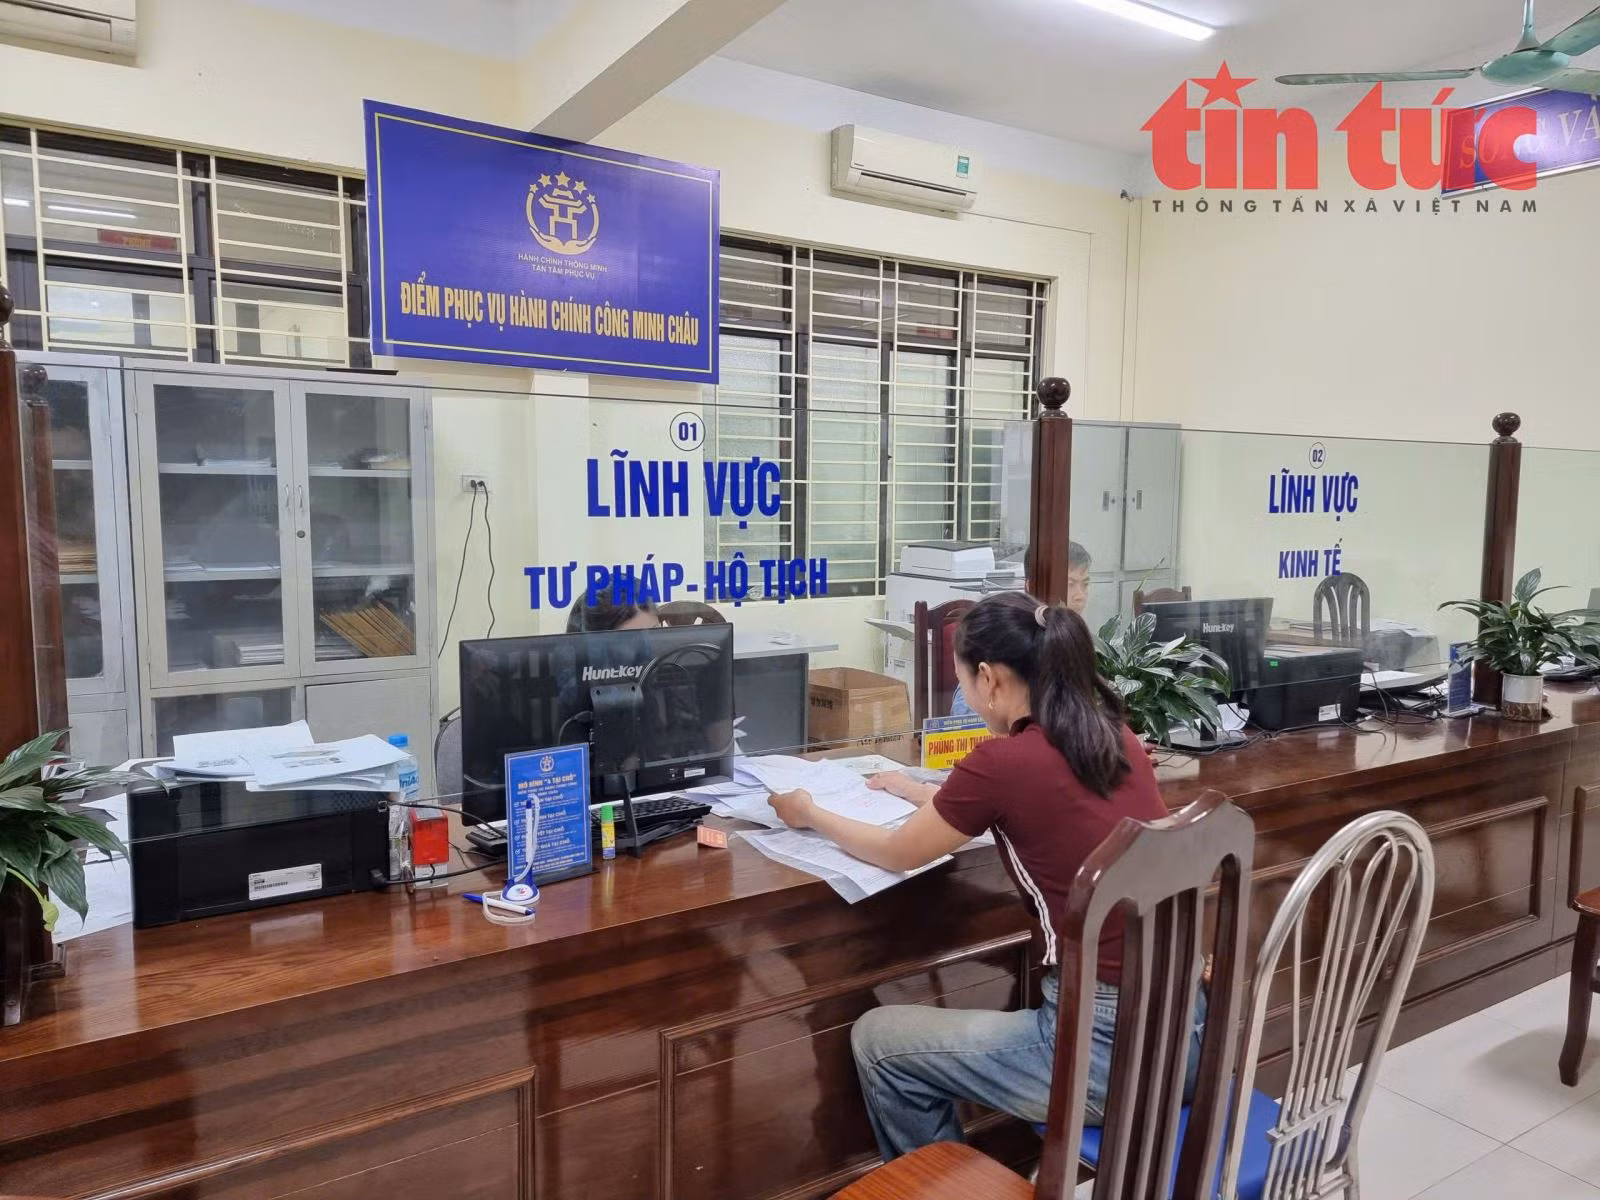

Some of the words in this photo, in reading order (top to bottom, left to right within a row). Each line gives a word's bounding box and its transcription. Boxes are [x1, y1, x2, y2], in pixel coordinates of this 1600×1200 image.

[400, 270, 441, 318] ĐIỂM
[444, 286, 484, 329] PHỤC
[487, 291, 506, 332] VỤ
[509, 289, 548, 330] HÀNH
[551, 296, 592, 335] CHÍNH
[594, 301, 630, 339] CÔNG
[632, 310, 665, 343] MINH
[667, 311, 699, 347] CHÂU
[678, 421, 698, 442] 01
[1312, 449, 1324, 463] 02
[586, 448, 689, 518] LĨNH
[703, 456, 781, 530] VỰC
[1268, 467, 1316, 514] LĨNH
[1322, 471, 1359, 522] VỰC
[523, 560, 577, 610] TƯ
[705, 551, 748, 608] HỘ
[759, 557, 828, 605] TỊCH
[1278, 549, 1319, 579] KINH
[1323, 538, 1344, 577] TẾ
